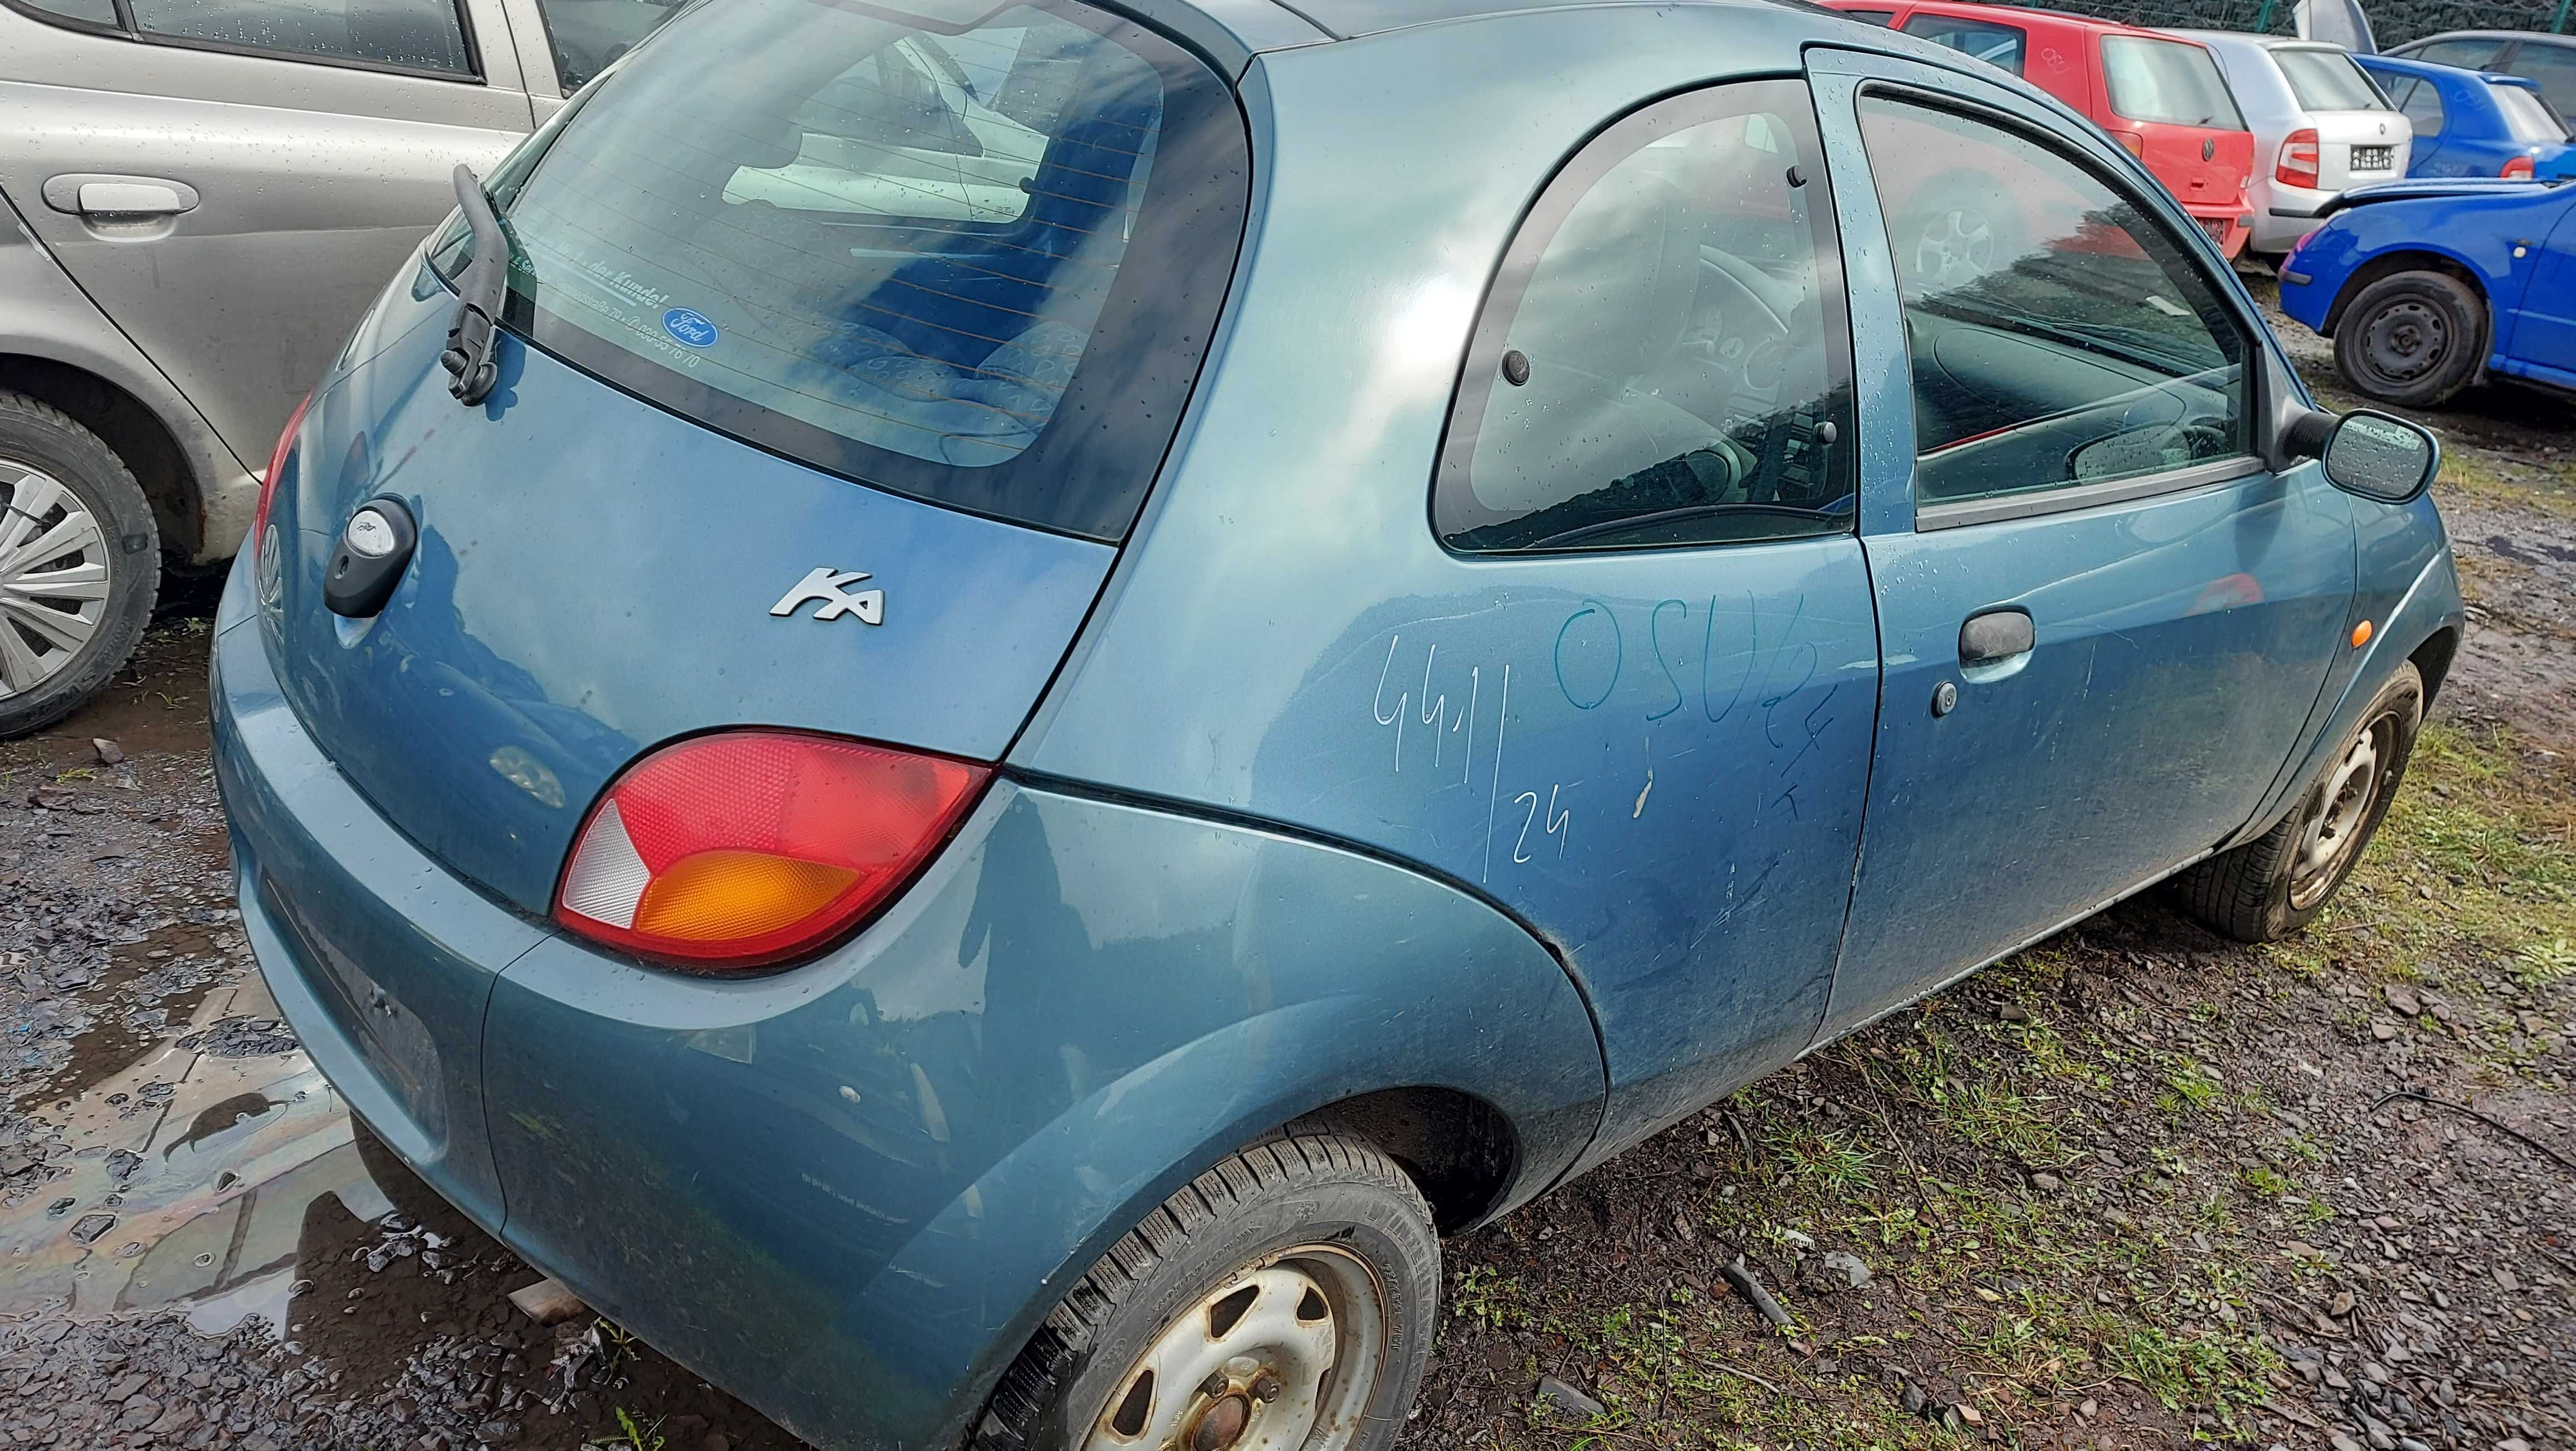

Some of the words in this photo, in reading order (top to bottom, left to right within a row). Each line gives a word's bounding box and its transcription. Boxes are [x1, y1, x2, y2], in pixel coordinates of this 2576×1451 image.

[587, 260, 615, 284] der
[609, 271, 669, 309] Kunde!
[682, 354, 701, 368] 70
